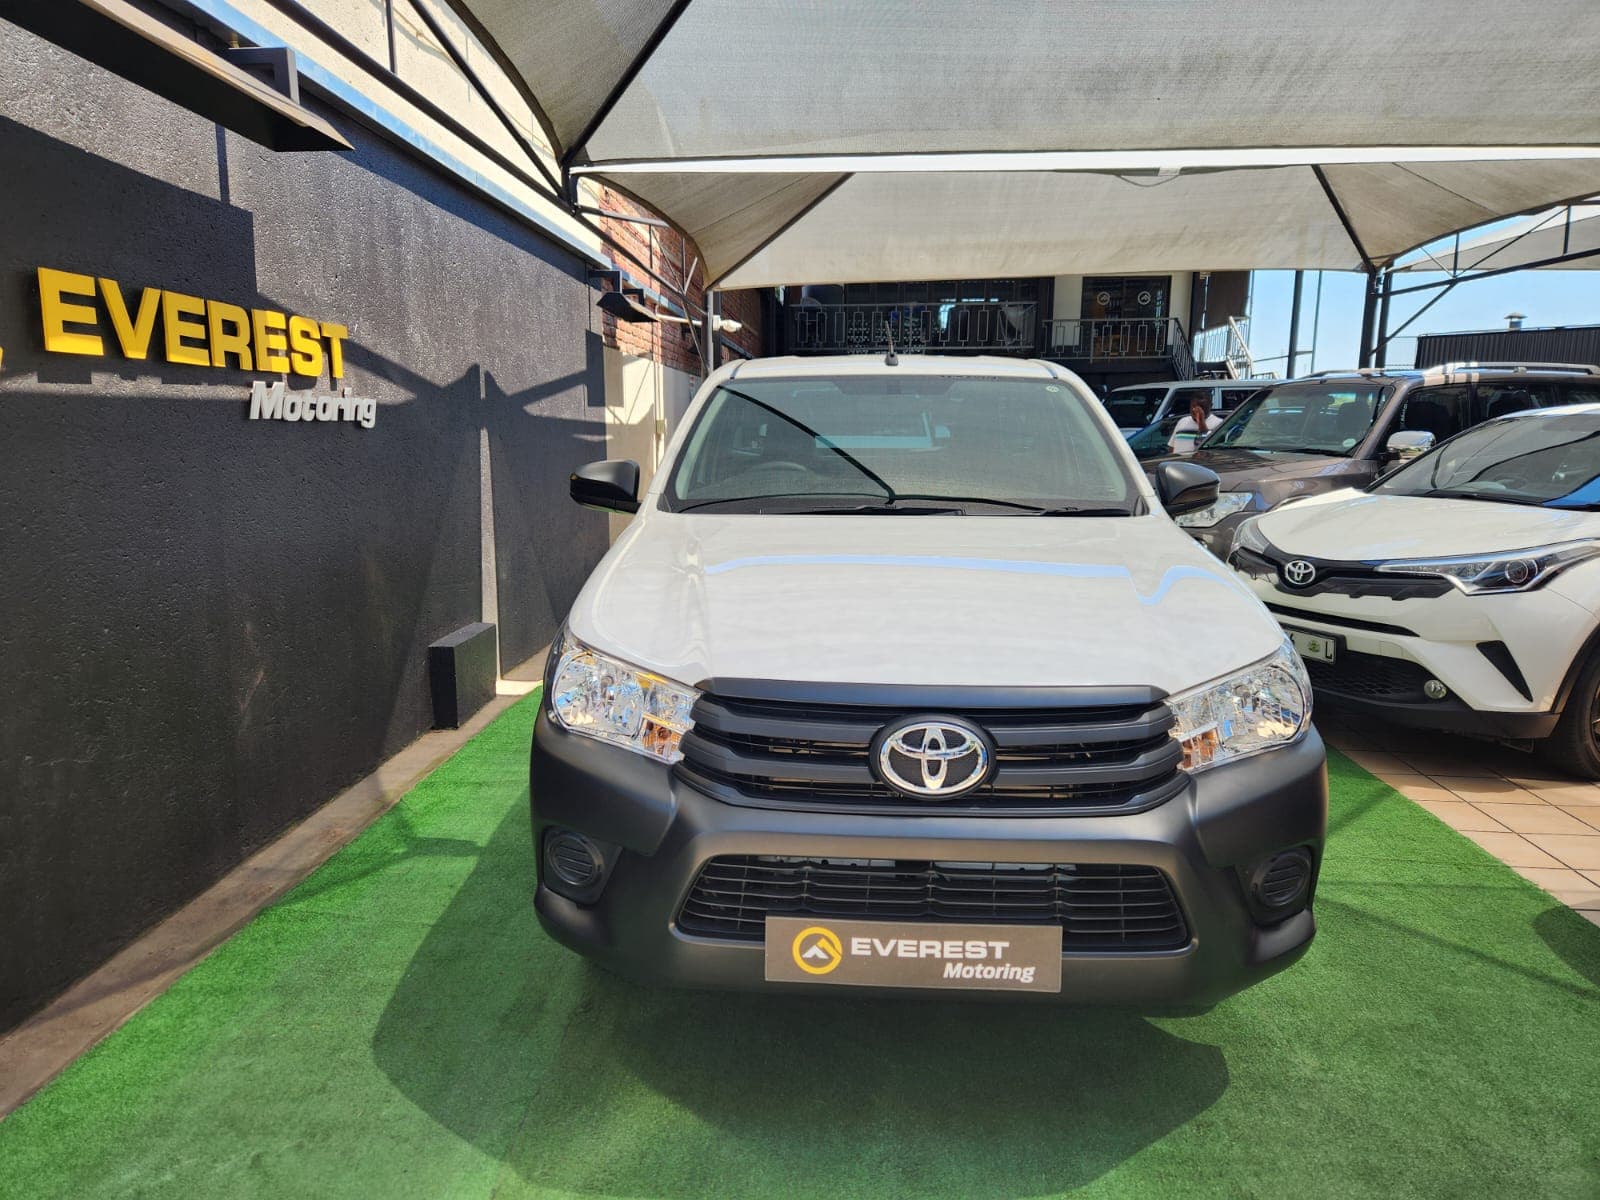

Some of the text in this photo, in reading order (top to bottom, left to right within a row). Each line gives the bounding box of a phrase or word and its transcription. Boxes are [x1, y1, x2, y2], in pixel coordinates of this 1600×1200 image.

[37, 266, 348, 379] EVEREST
[249, 380, 377, 429] Motoring
[851, 936, 1010, 960] EVEREST
[943, 962, 1036, 984] Motoring
